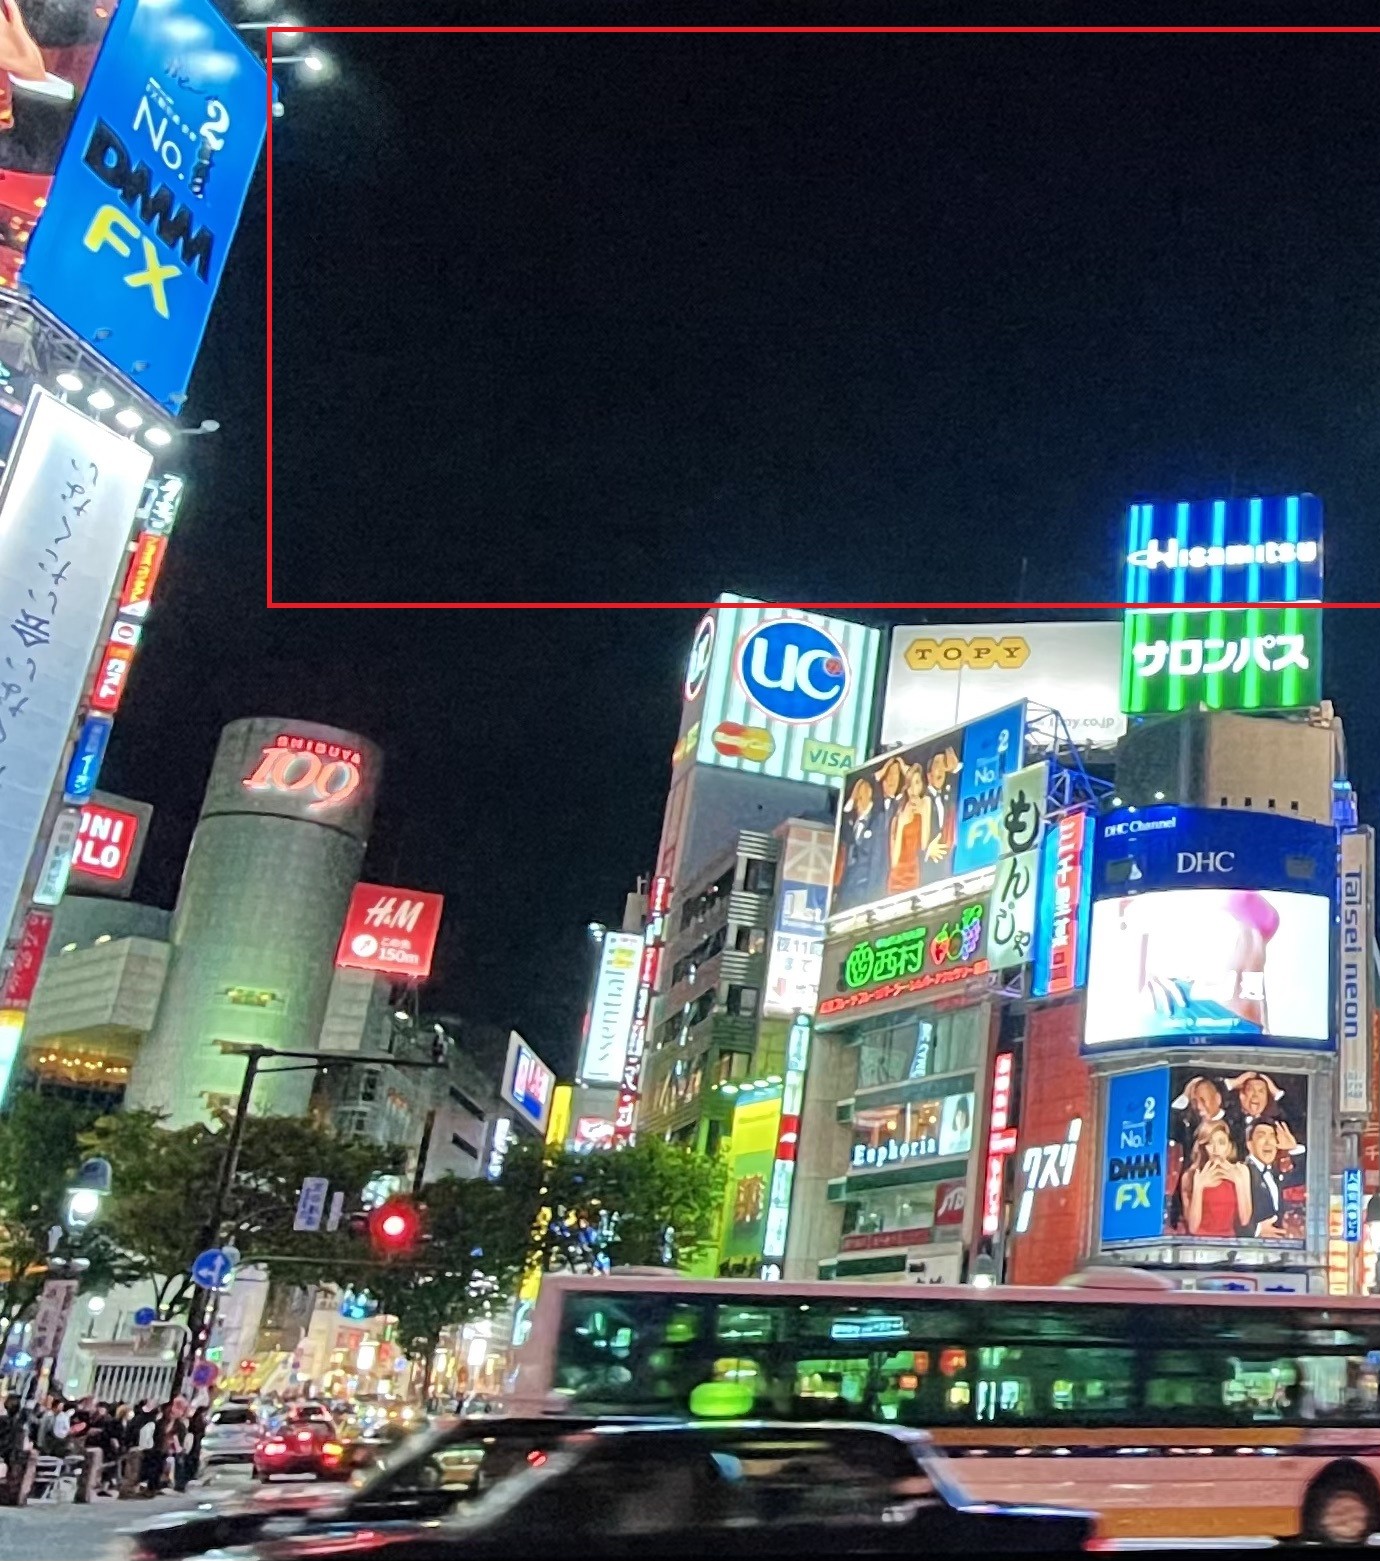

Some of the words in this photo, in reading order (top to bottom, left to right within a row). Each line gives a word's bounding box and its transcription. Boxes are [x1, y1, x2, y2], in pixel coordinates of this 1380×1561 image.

[82, 116, 215, 285] DMM
[84, 204, 183, 319] FX
[1128, 538, 1317, 569] Hisamitsu
[752, 637, 841, 700] UC
[915, 646, 1022, 661] TOPY
[1132, 635, 1310, 677] サロンパス
[277, 736, 361, 764] SHIBUYA
[809, 748, 852, 769] VISA
[242, 747, 360, 810] 109
[1104, 822, 1129, 838] DHC
[1130, 816, 1177, 833] Channel
[994, 789, 1041, 958] もんじゃ
[1176, 851, 1235, 873] DHC
[364, 896, 425, 932] H&M
[874, 940, 924, 980] 西村
[1344, 963, 1359, 1038] neon
[852, 1136, 937, 1167] Euphoria
[1109, 1153, 1161, 1181] DMM
[1115, 1182, 1151, 1211] FX
